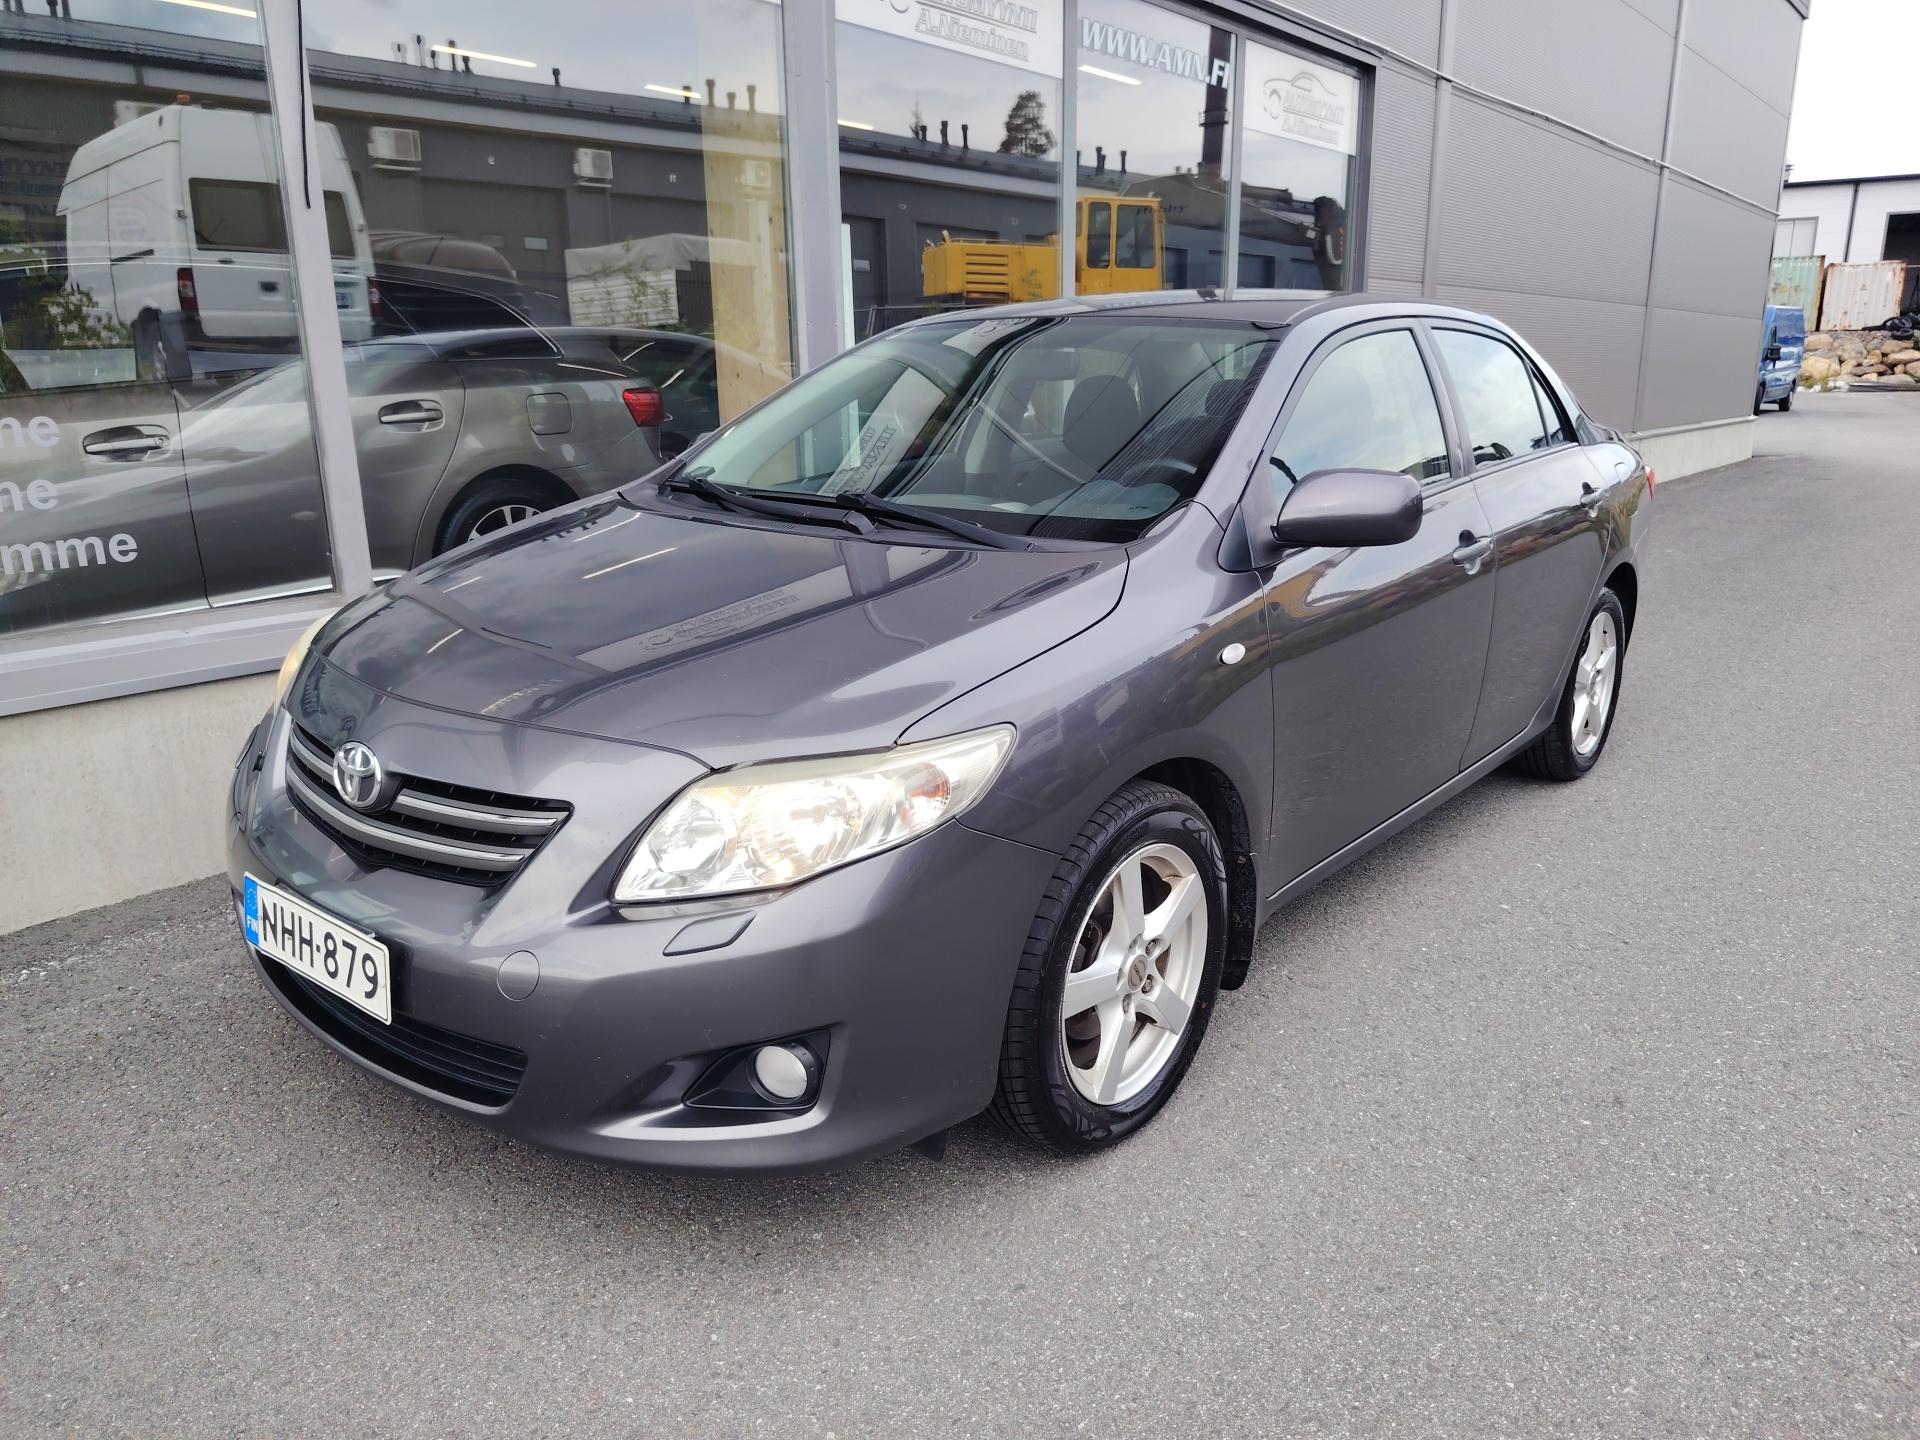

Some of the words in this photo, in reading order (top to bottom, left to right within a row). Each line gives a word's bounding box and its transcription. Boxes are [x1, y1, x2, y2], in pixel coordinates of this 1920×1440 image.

[914, 8, 1030, 59] A.Nieminen
[1082, 17, 1231, 89] WWW.AMN.FI
[261, 896, 379, 999] NHH-879
